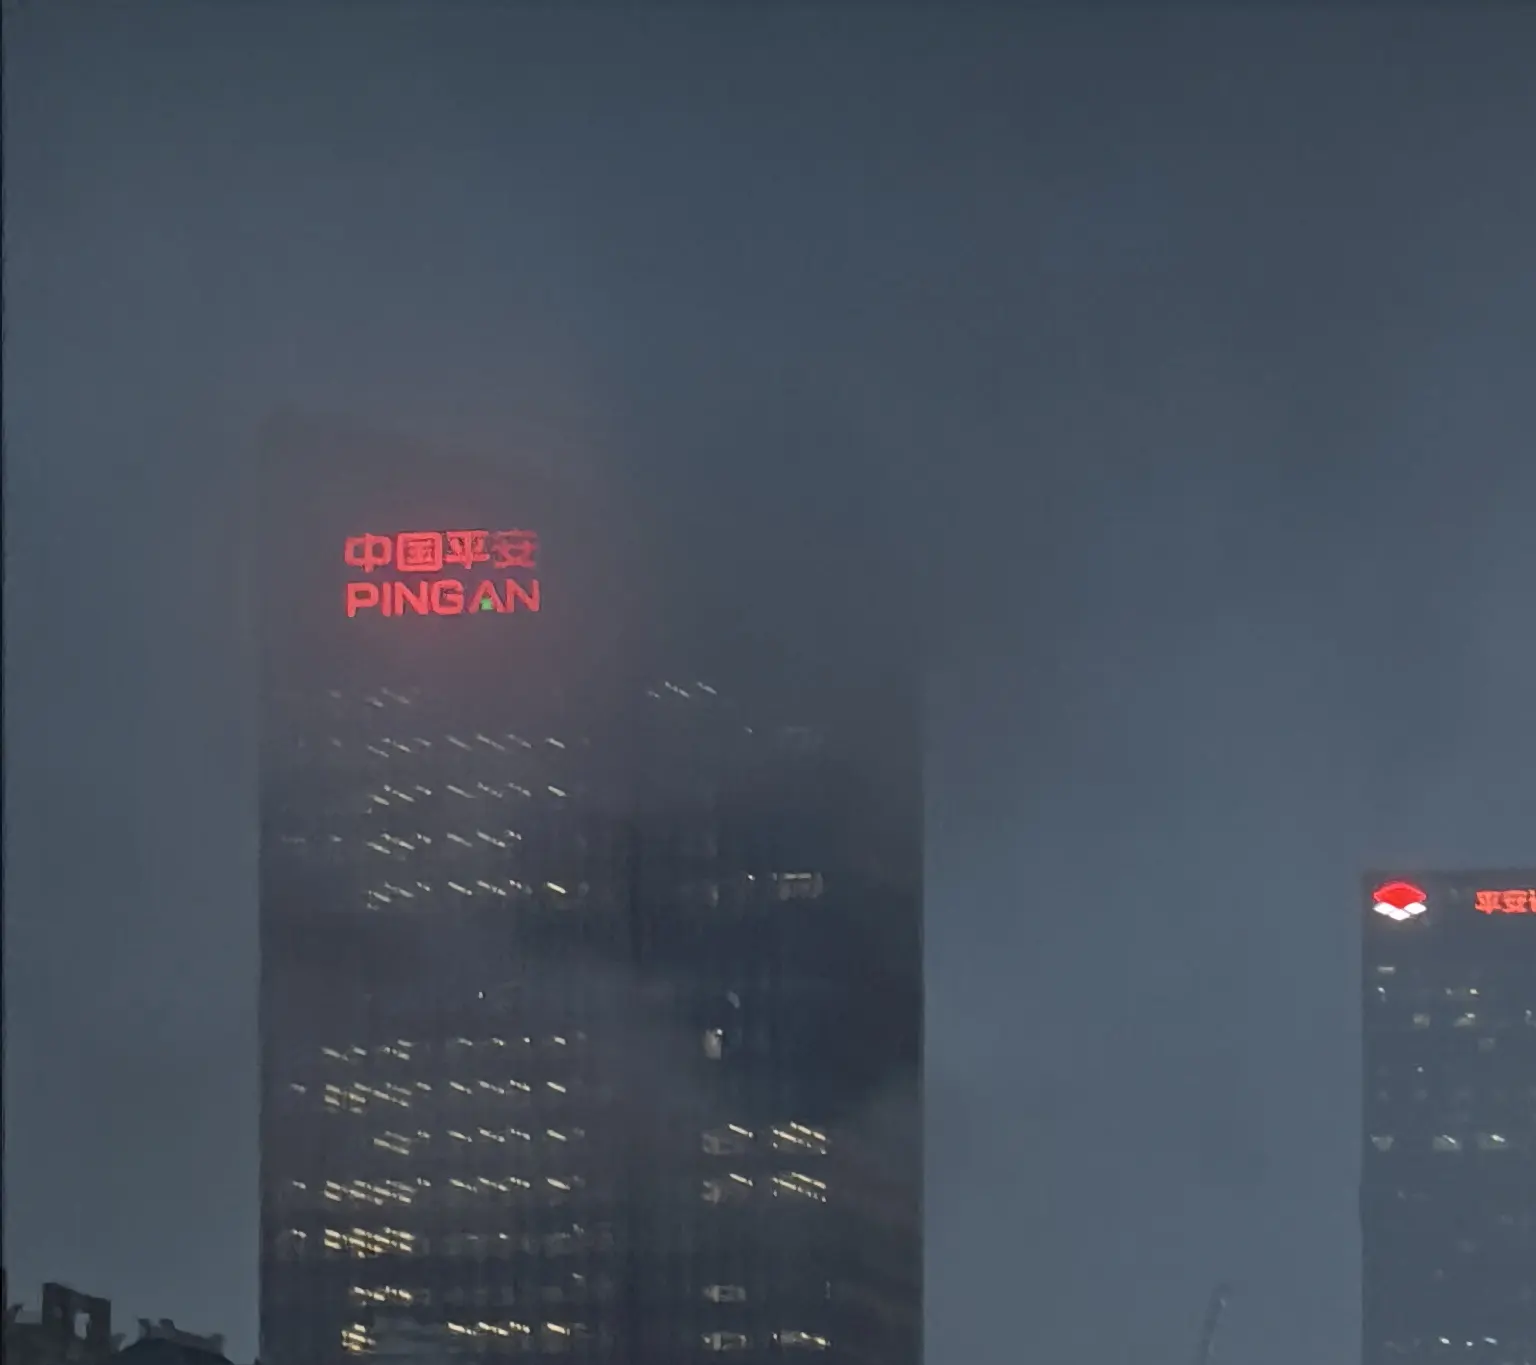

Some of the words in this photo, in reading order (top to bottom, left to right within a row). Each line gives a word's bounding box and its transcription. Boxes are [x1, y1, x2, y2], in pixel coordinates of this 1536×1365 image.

[344, 529, 539, 573] 中国平安
[345, 579, 540, 617] PINGAN
